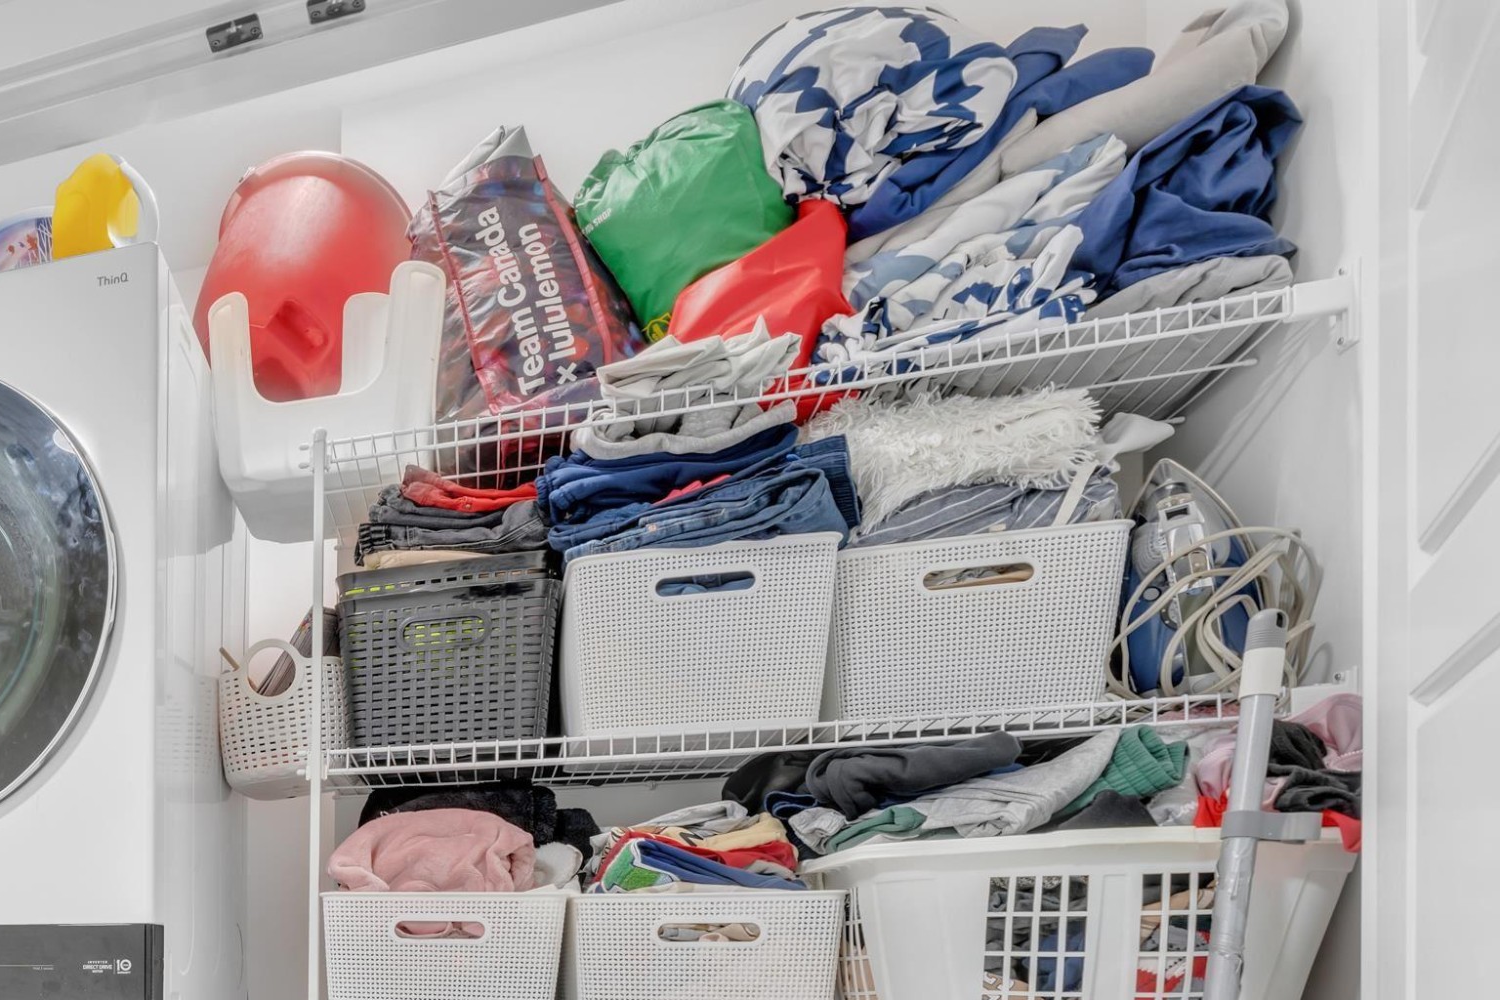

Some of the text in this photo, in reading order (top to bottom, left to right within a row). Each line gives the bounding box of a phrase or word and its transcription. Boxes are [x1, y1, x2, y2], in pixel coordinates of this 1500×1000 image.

[96, 271, 129, 287] ThinQ
[475, 206, 546, 396] Team Canada
[518, 223, 577, 361] lululemon
